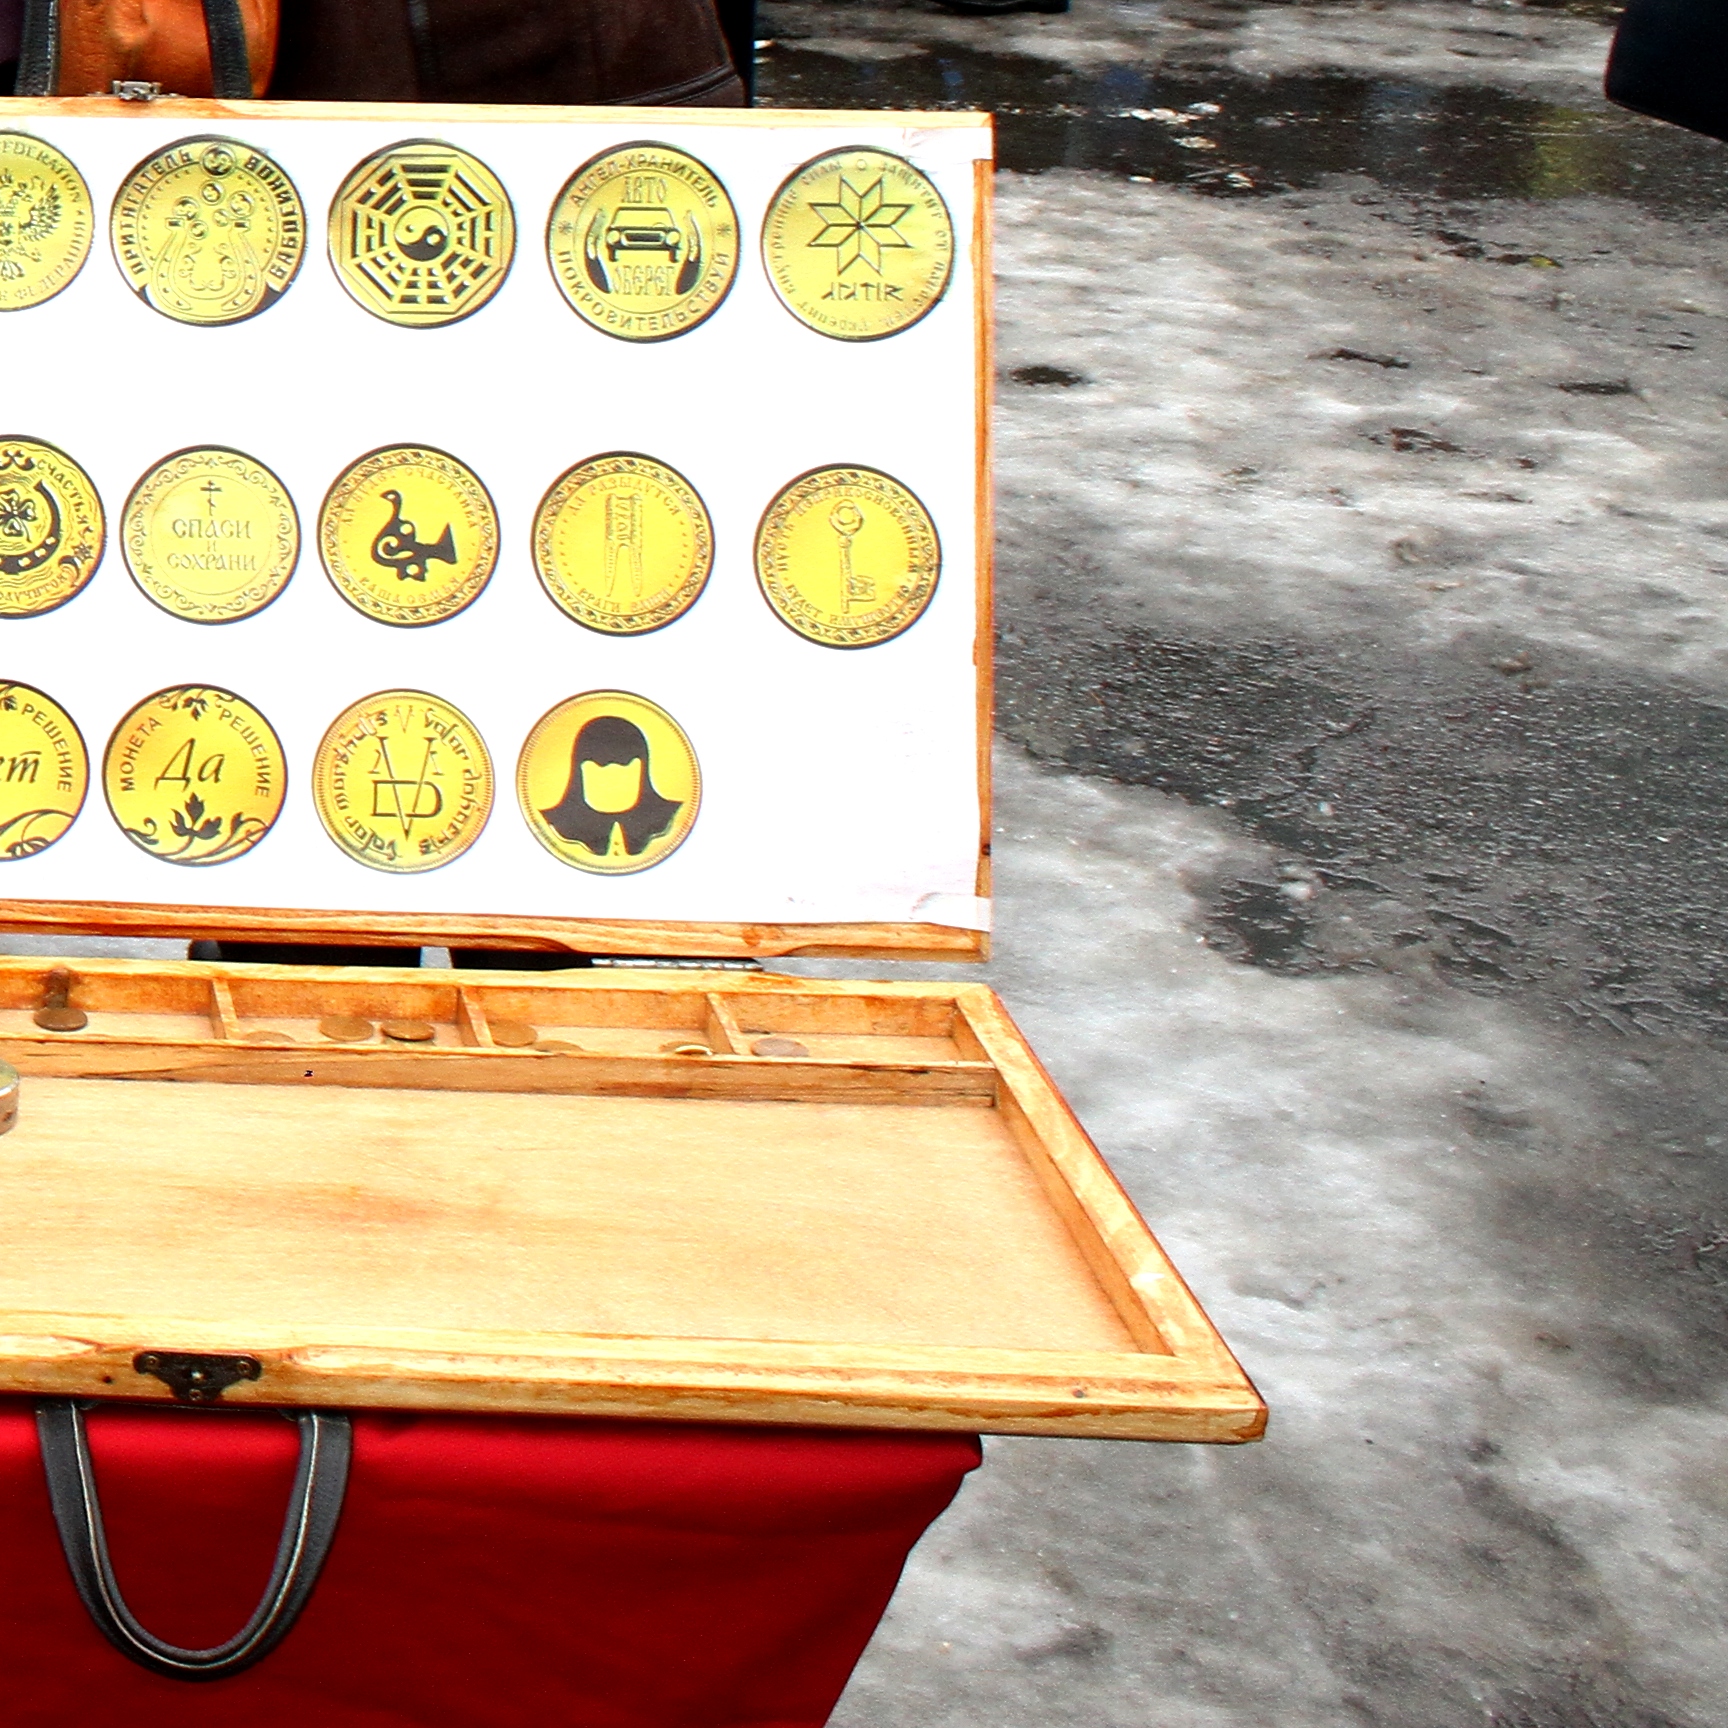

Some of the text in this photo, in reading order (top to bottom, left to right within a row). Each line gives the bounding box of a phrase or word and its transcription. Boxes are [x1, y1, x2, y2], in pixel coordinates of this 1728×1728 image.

[571, 153, 718, 209] АНГЕЛ-ХРАНИТЕЛЬ
[621, 176, 667, 204] АВТО
[120, 149, 194, 276] ПРИТЯГАТЕЛЬ
[14, 221, 86, 300] ФЕДЕРАЦИЯ
[557, 250, 731, 331] ПОКРОВИТЕЛЬСТВУЙ
[172, 519, 252, 539] СПАСИ
[207, 540, 217, 553] И
[167, 553, 257, 571] СОХРАНИ
[21, 703, 73, 793] РЕШЕНИЕ
[120, 708, 271, 797] МОНЕТА РЕШЕНИЕ
[154, 738, 224, 792] Да
